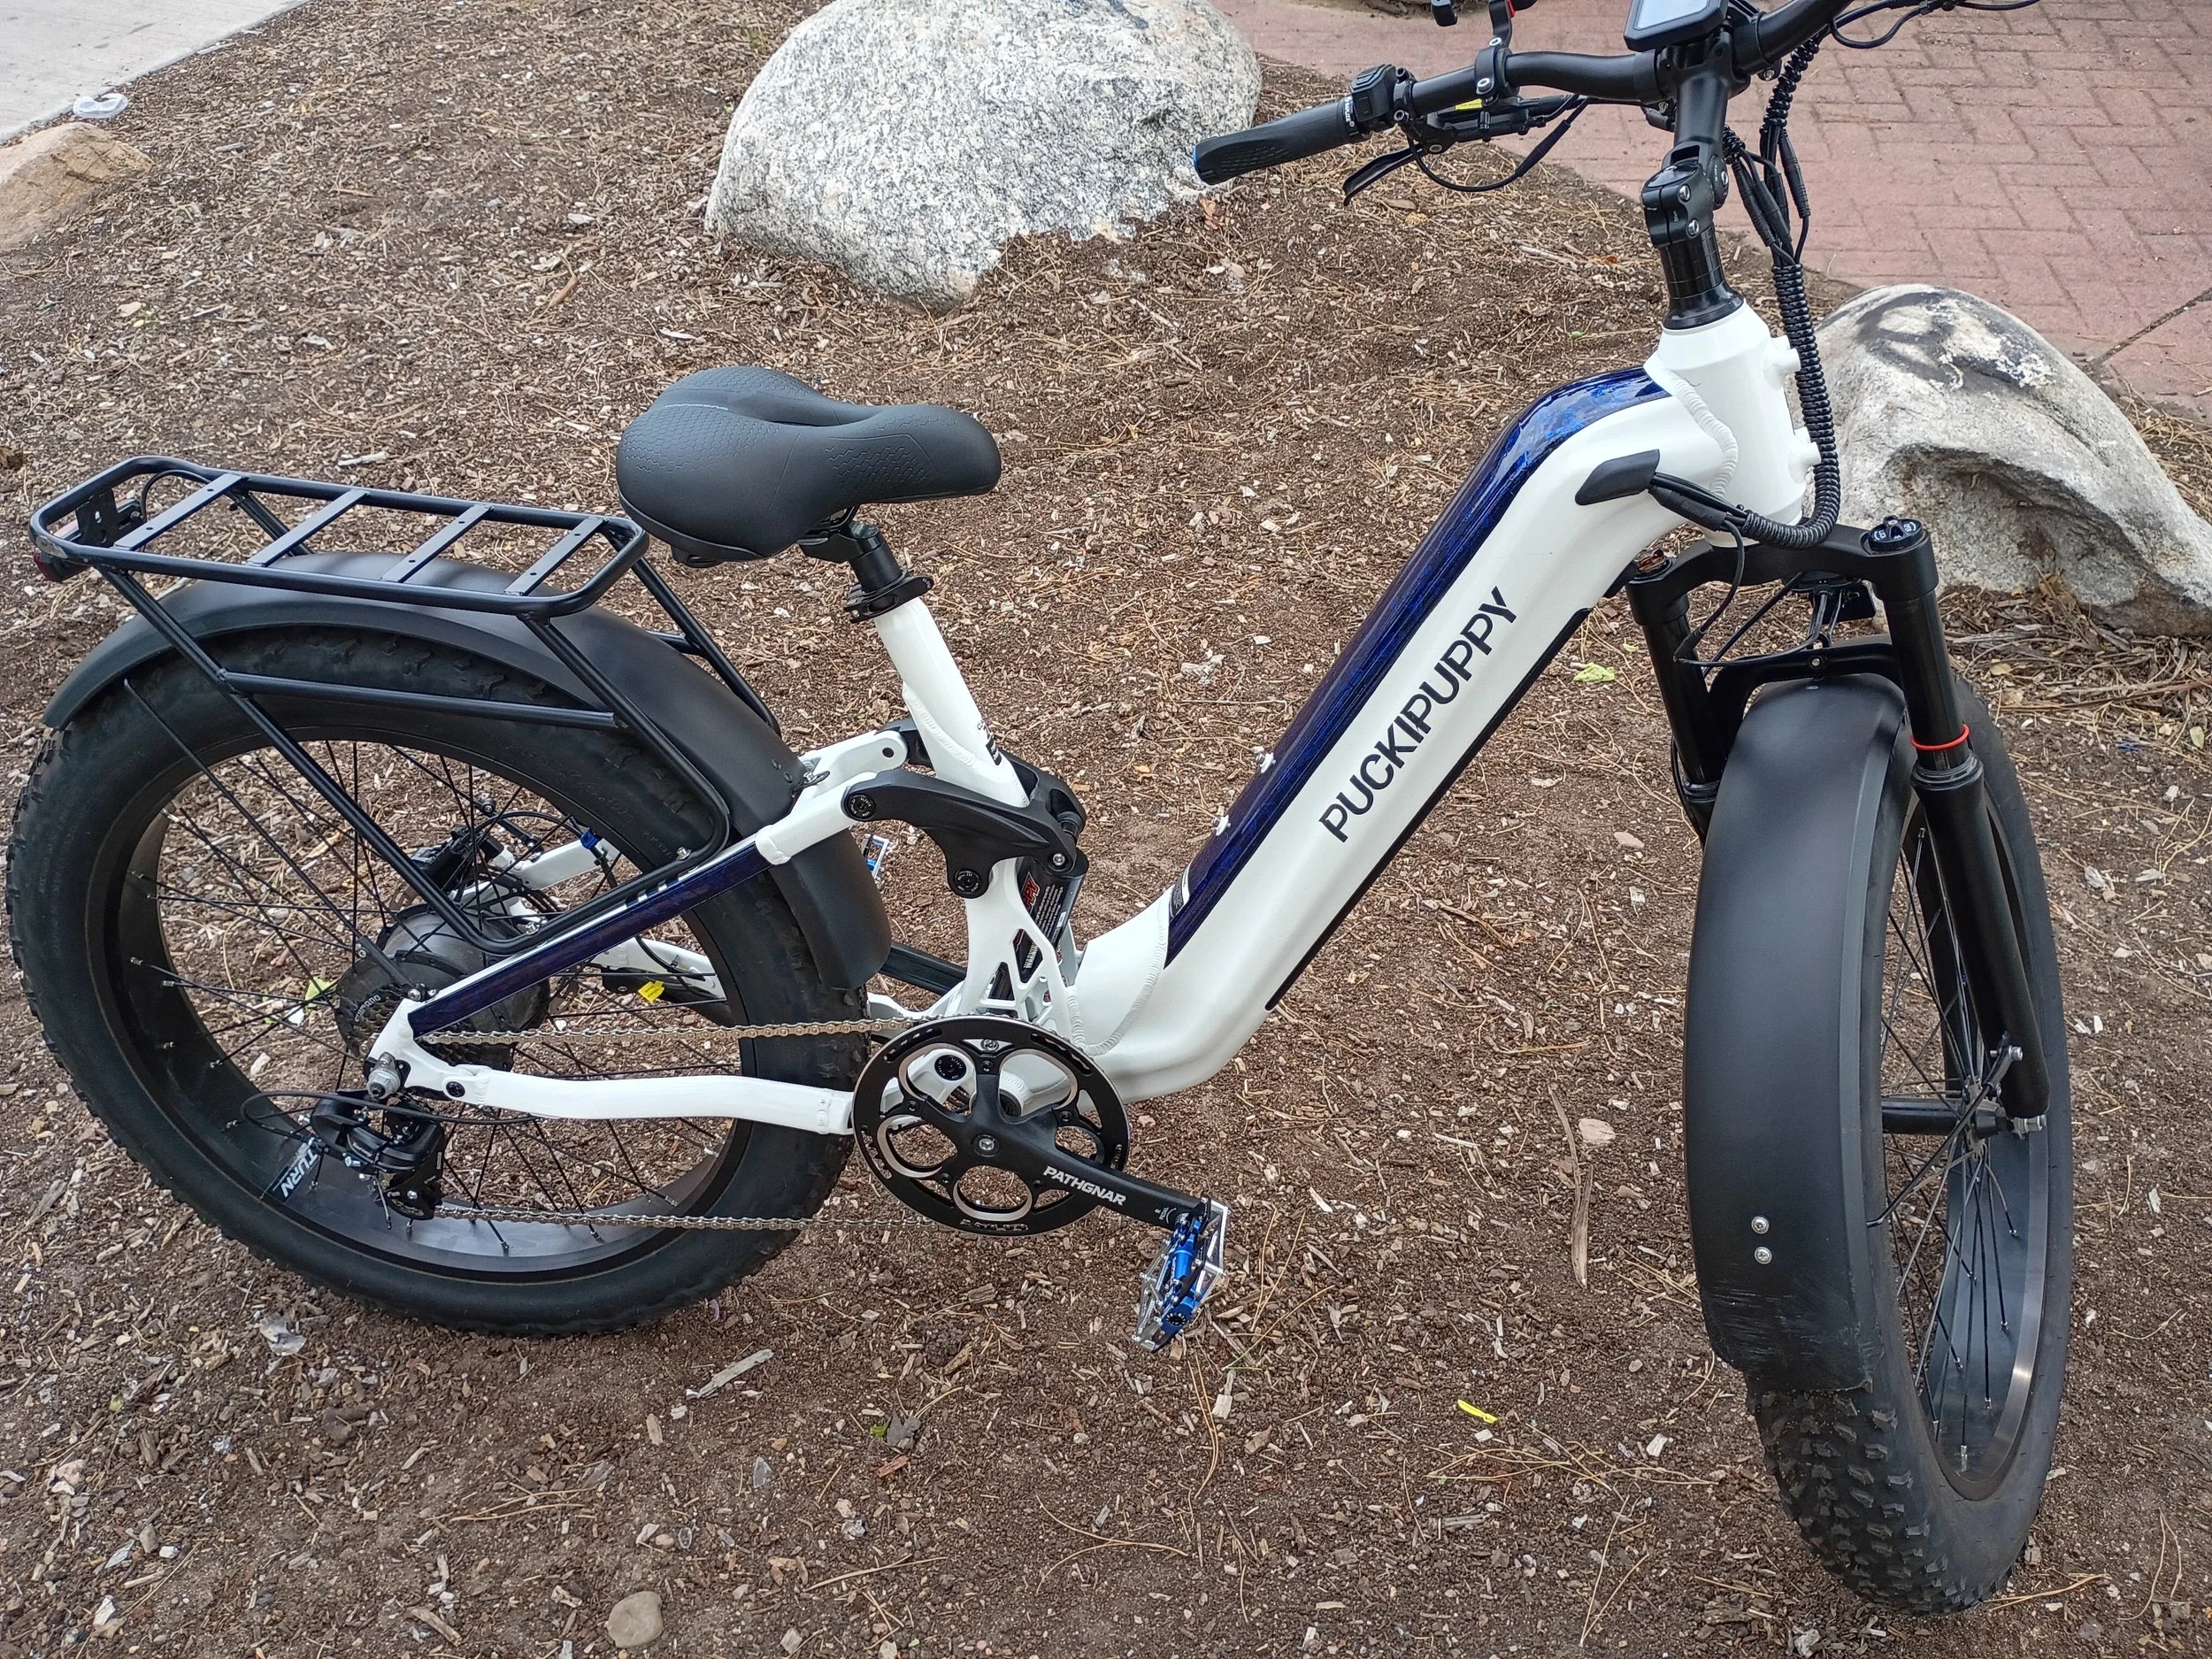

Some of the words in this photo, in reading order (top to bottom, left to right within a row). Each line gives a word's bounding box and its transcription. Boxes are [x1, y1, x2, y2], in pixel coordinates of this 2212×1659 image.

[1318, 586, 1517, 842] PUCKIPUPPY
[1023, 941, 1039, 969] WARNIN
[1043, 1165, 1127, 1206] PATHGNAR
